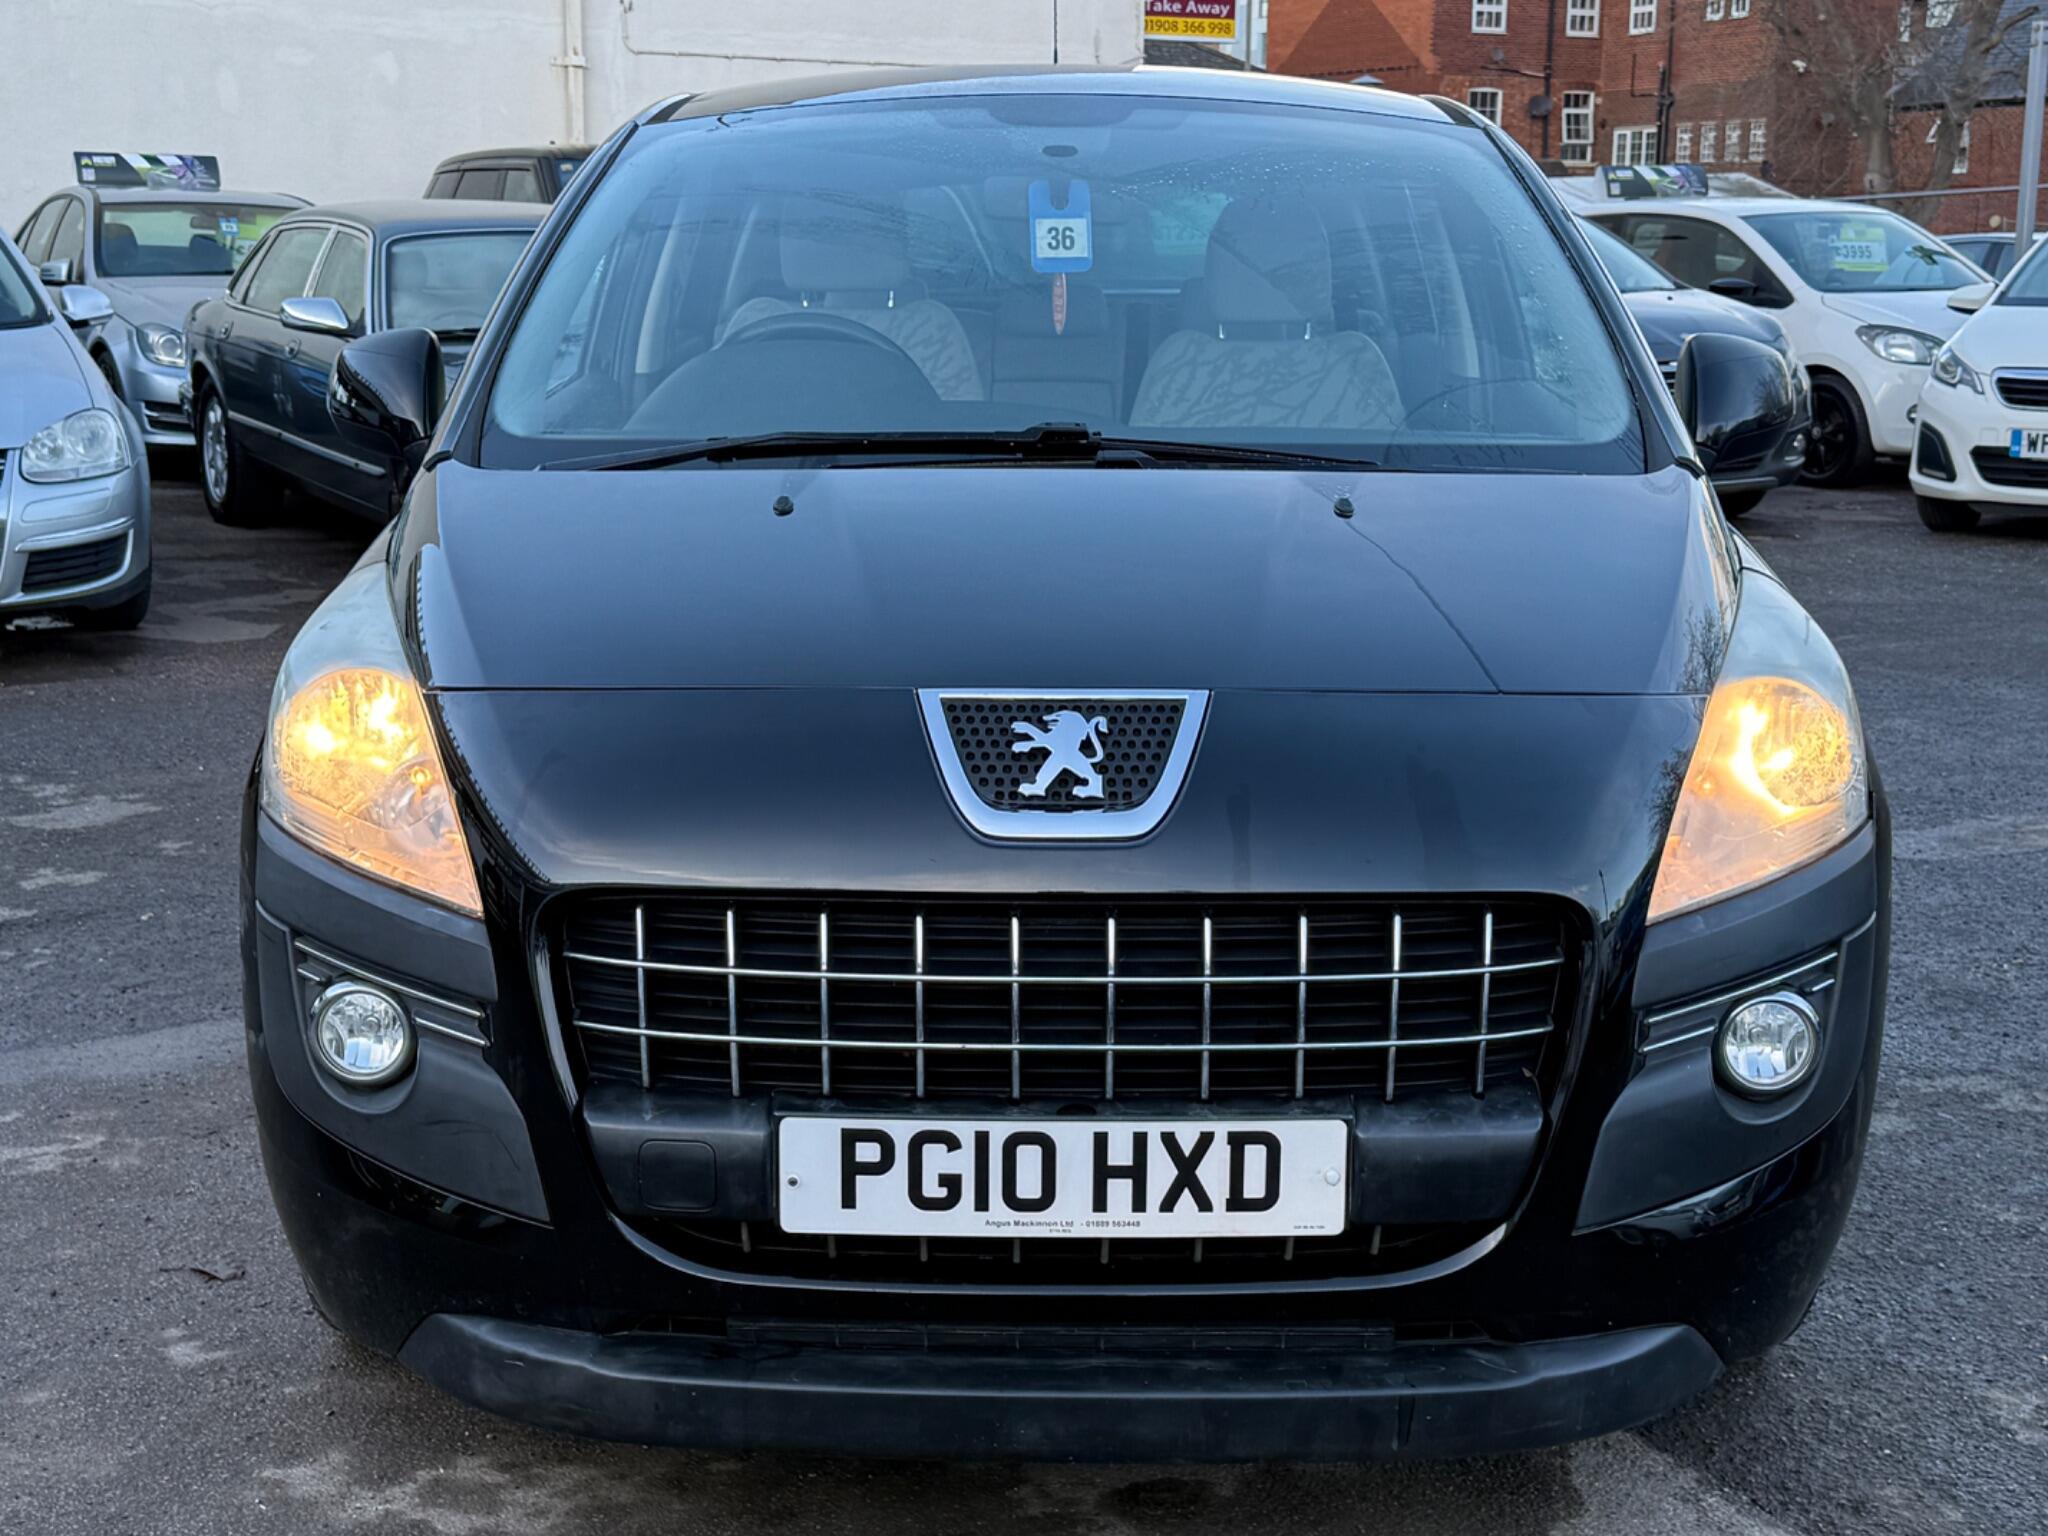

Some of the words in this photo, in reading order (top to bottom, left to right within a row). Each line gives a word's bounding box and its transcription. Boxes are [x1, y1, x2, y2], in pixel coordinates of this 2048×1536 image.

[1186, 0, 1230, 17] Away
[1181, 20, 1205, 33] 366
[1208, 22, 1232, 35] 998
[1046, 226, 1075, 250] 36
[840, 1127, 1057, 1213] PG10
[1091, 1130, 1282, 1213] HXD
[984, 1219, 1011, 1228] Angus
